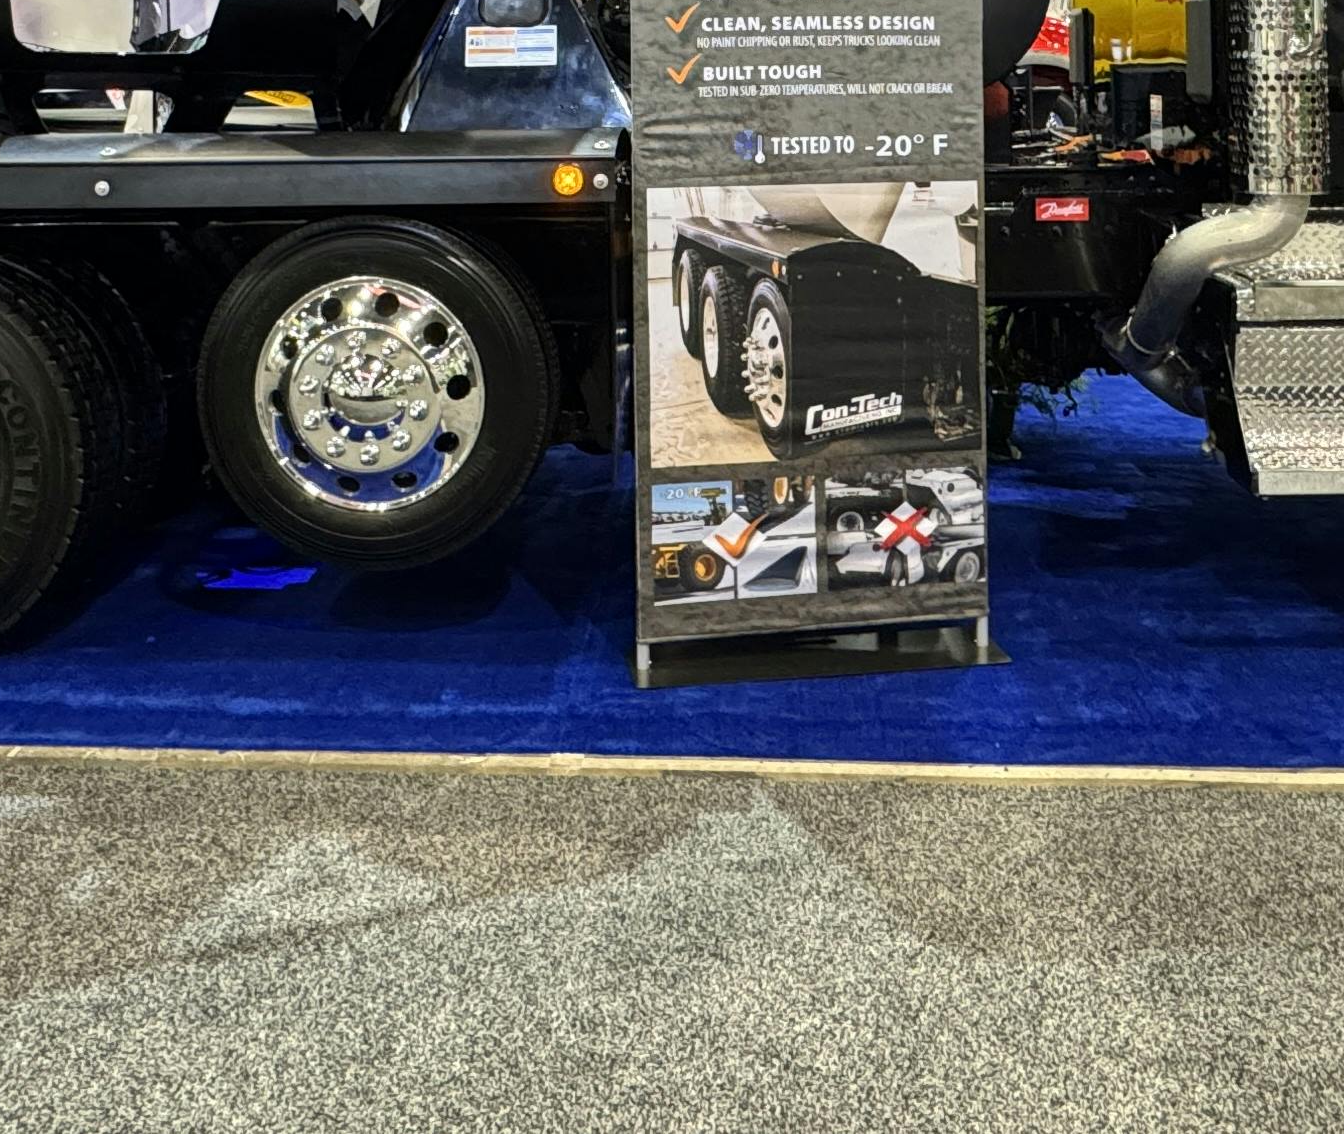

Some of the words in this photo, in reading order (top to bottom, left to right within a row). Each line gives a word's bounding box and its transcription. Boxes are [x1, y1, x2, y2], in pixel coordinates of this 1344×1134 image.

[701, 16, 767, 33] CLEAN,
[771, 16, 864, 31] SEAMLESS
[868, 16, 935, 30] DESIGN
[696, 36, 710, 49] NO
[711, 36, 736, 48] PAINT
[737, 36, 778, 48] CHIPPING
[779, 36, 791, 47] OR
[817, 36, 843, 47] KEEPS
[844, 35, 875, 46] TRUCKS
[876, 35, 913, 46] LOOKING
[913, 35, 941, 46] CLEAN
[703, 65, 755, 82] BUILT
[758, 64, 822, 80] TOUGH
[698, 86, 728, 98] TESTED
[729, 86, 739, 97] IN
[847, 84, 868, 95] WILL
[869, 83, 885, 95] NOT
[886, 83, 912, 94] CRACK
[913, 83, 925, 94] OR
[926, 83, 953, 94] BREAK
[770, 136, 831, 155] TESTED
[834, 135, 855, 154] TO
[933, 133, 949, 156] F
[805, 392, 902, 436] Con-Tech
